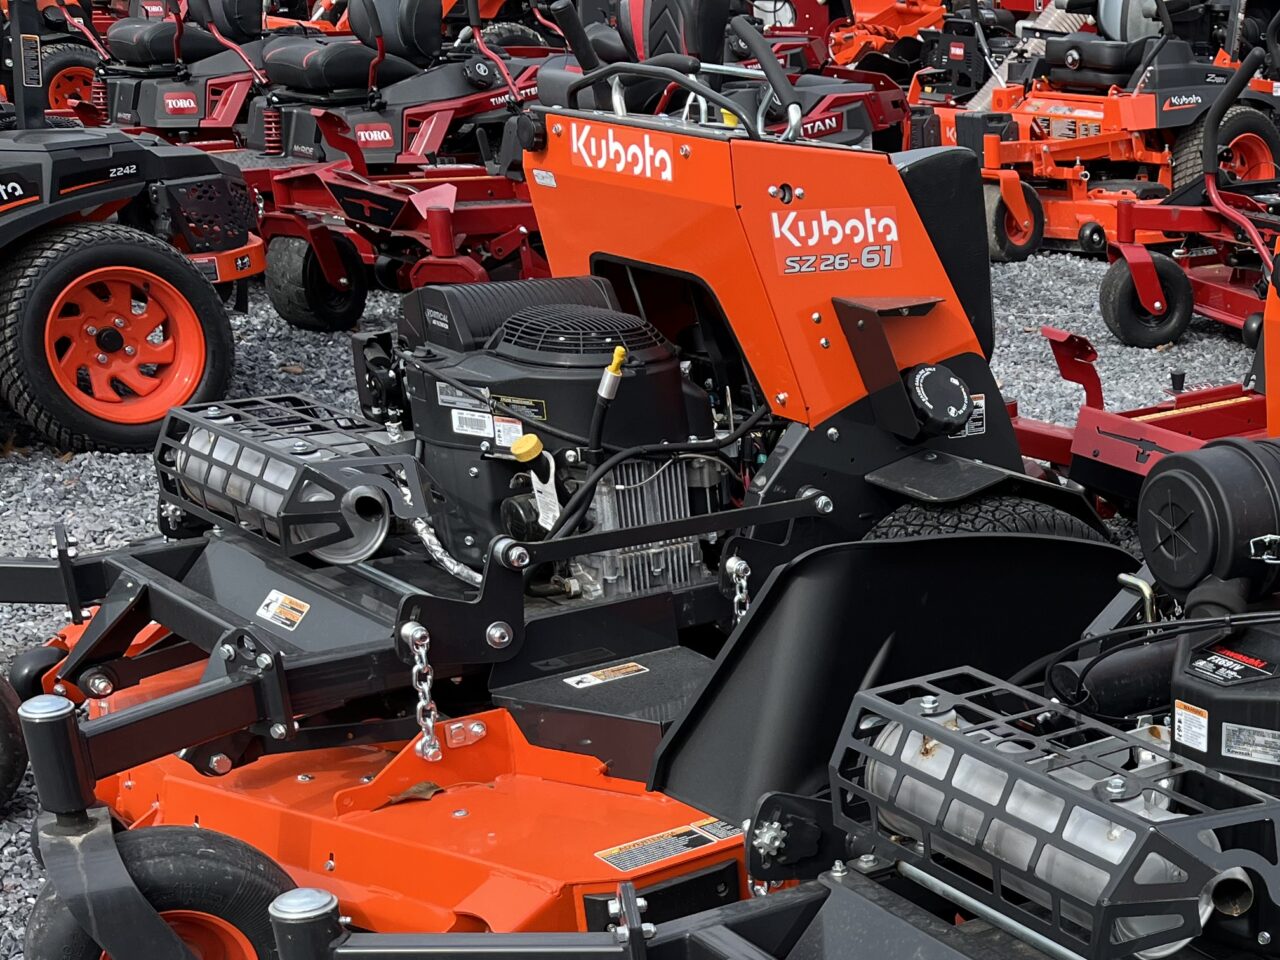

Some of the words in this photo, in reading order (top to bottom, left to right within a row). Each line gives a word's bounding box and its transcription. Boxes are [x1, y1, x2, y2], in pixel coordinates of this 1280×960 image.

[167, 99, 196, 109] TORO
[1171, 94, 1202, 105] Kubota
[358, 130, 392, 142] TORO
[571, 122, 673, 182] Kubota
[109, 164, 137, 178] Z242
[771, 207, 899, 247] Kubota
